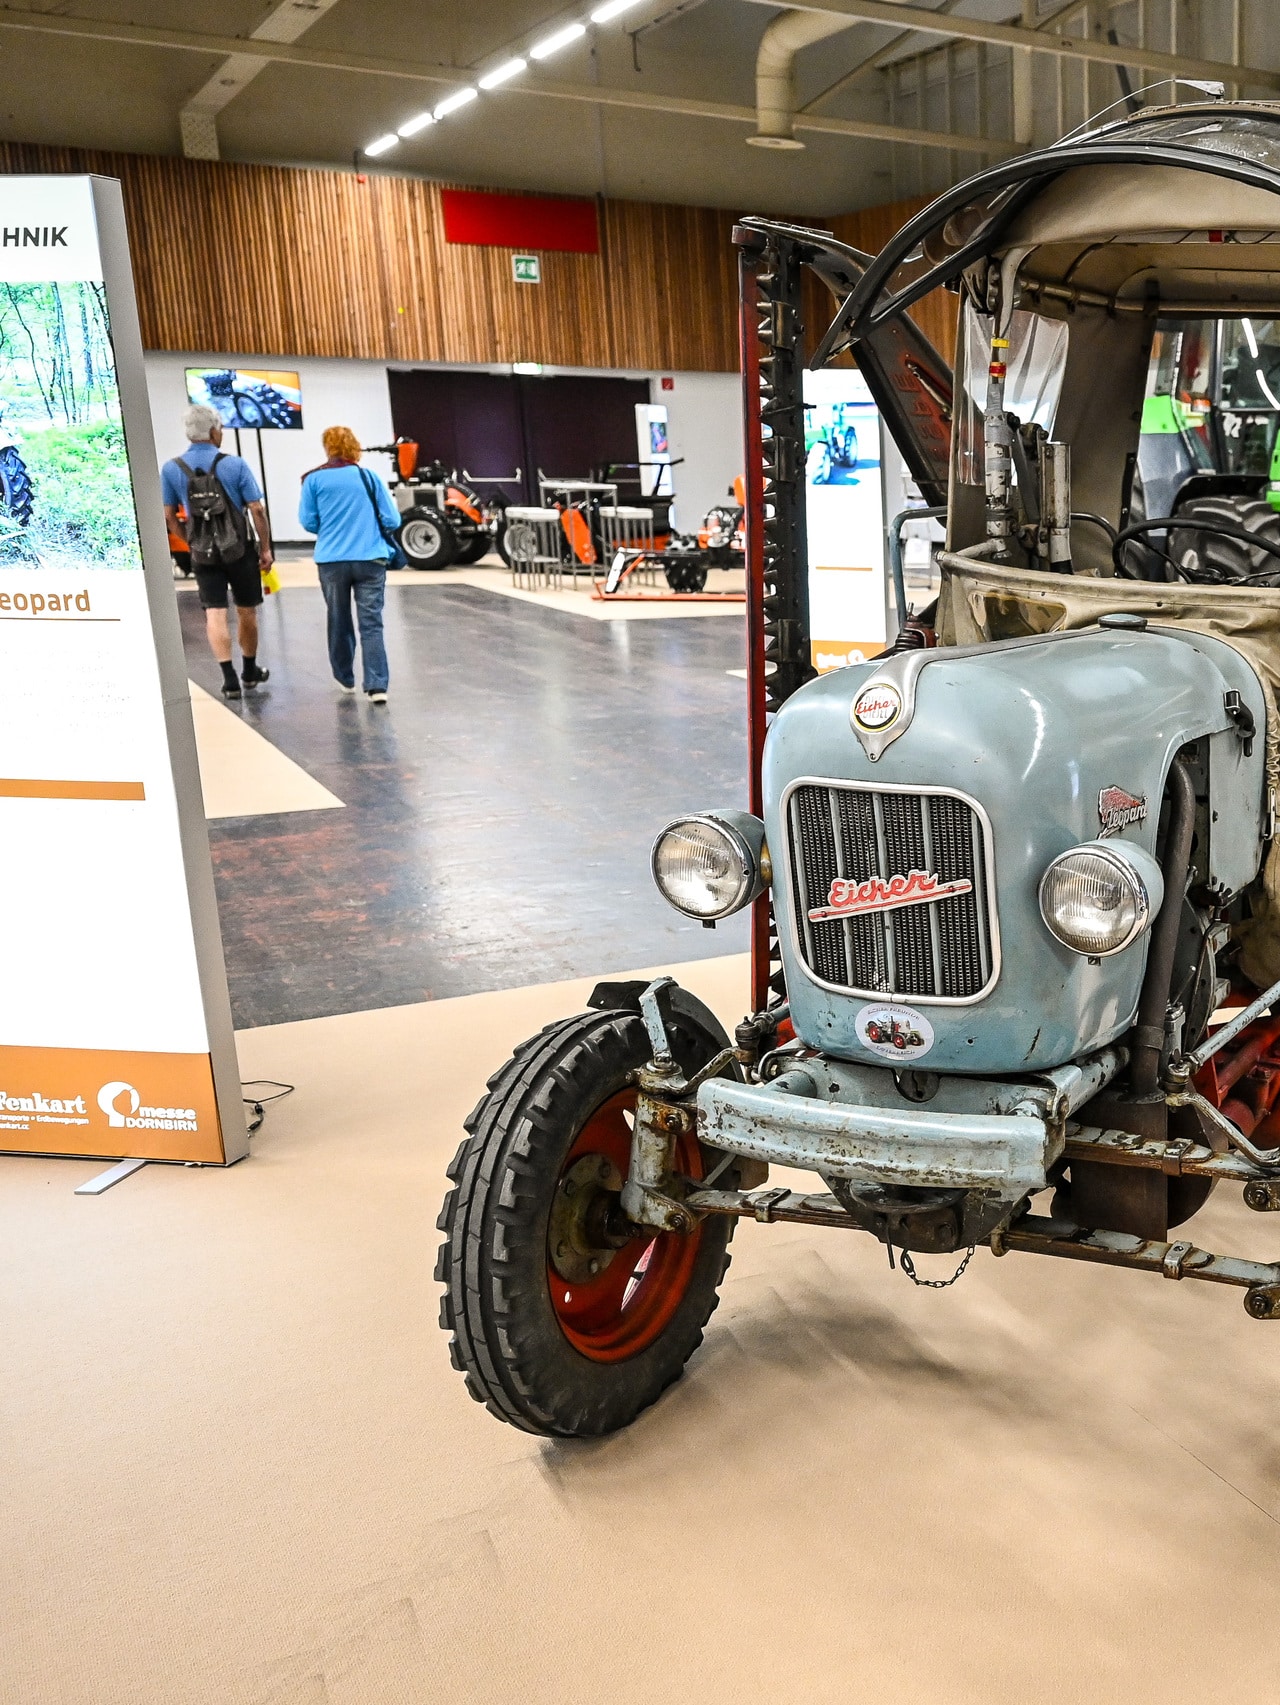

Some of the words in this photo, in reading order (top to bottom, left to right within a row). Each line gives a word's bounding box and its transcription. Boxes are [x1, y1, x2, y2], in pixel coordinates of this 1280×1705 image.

[3, 226, 69, 247] HNIK
[0, 589, 91, 615] eopard
[856, 700, 897, 714] Eicher
[828, 869, 939, 908] Eicher
[139, 1106, 197, 1120] messe
[126, 1118, 198, 1131] DORNBIRN
